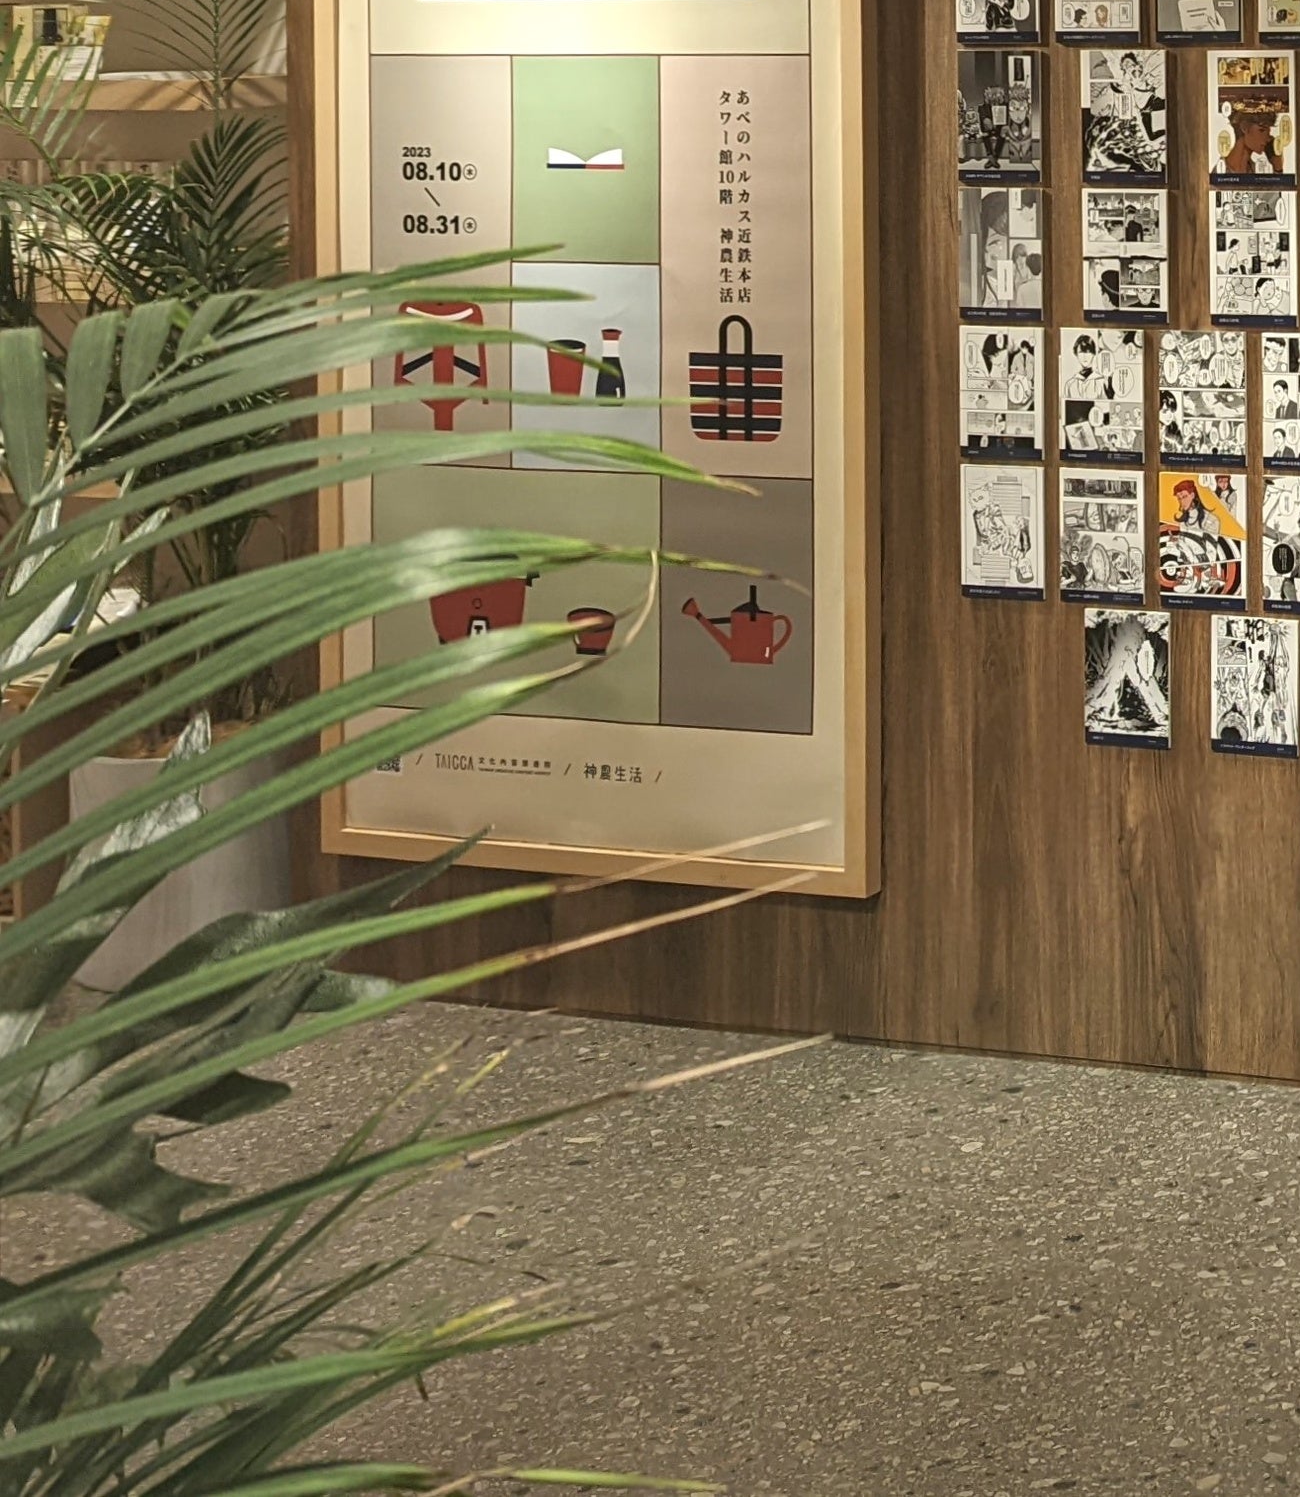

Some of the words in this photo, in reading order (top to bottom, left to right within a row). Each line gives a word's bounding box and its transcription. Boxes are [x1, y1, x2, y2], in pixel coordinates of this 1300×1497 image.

[402, 146, 431, 158] 2023
[719, 89, 735, 206] タワー館10階
[737, 89, 752, 304] あべのハルカス近鉄本店
[719, 227, 735, 304] 神農生活
[435, 753, 474, 771] TAICCA
